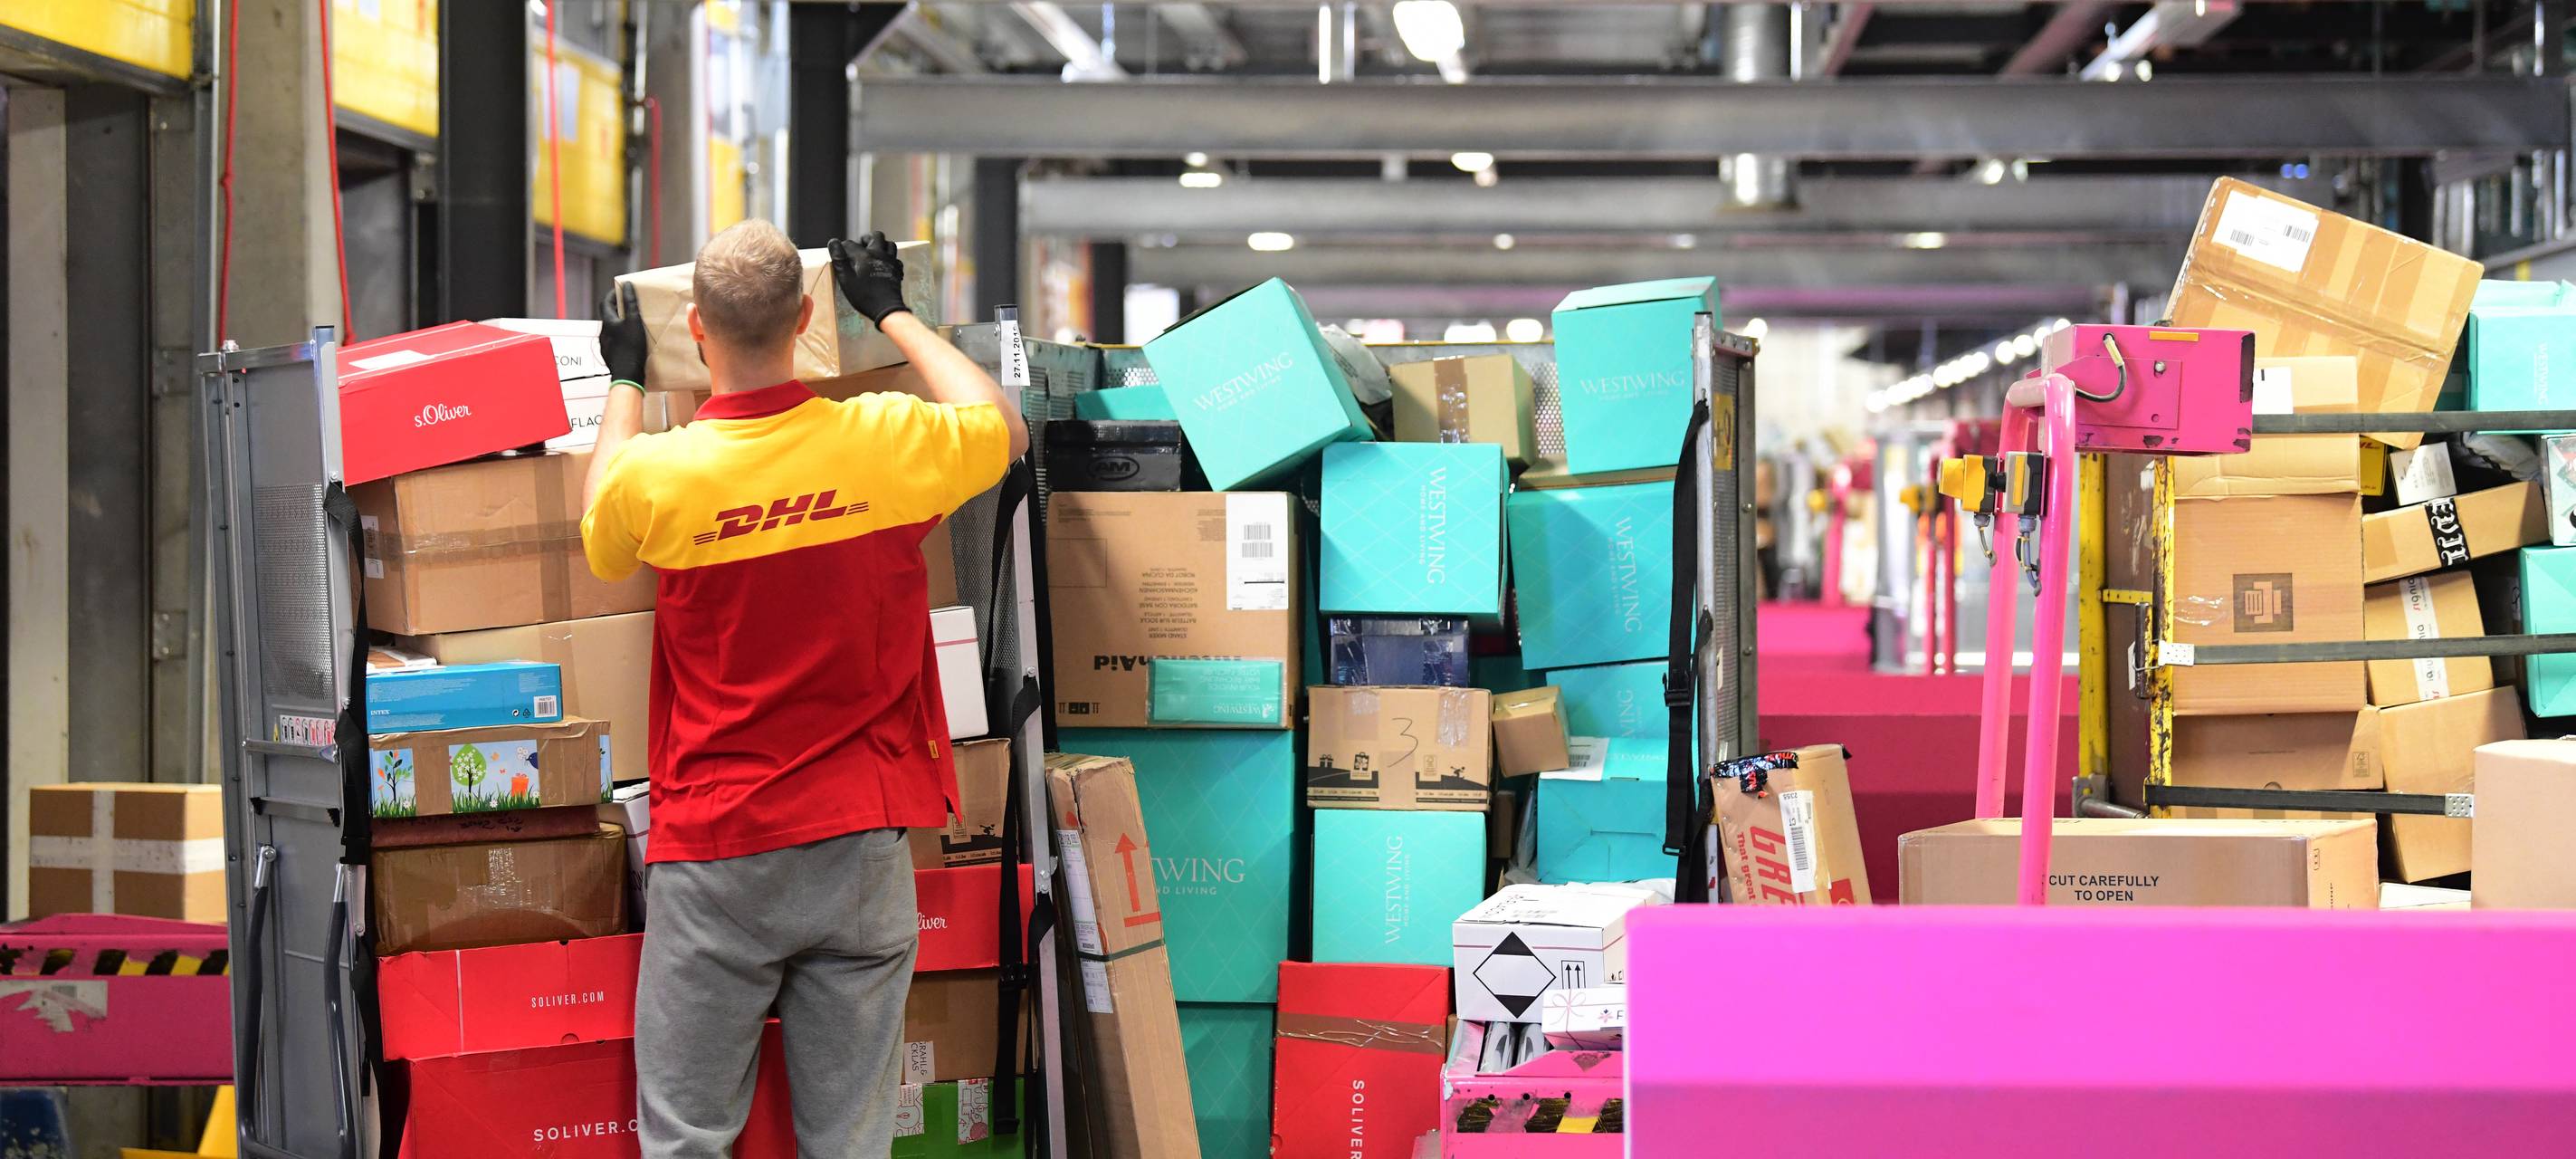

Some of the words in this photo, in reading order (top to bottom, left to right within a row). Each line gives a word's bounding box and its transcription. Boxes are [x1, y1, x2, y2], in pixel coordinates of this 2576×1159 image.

[1192, 350, 1293, 411] WESTWING
[1578, 369, 1685, 395] WESTWING
[414, 403, 472, 427] s.Oliver
[714, 489, 849, 541] DHL
[1426, 466, 1447, 585] WESTWING
[1615, 516, 1643, 633] WESTWING
[1387, 716, 1419, 768] 3
[1175, 886, 1217, 896] LIVING
[1384, 834, 1403, 945] WESTWING
[2048, 875, 2075, 886] CUT
[2079, 875, 2160, 886] CAREFULLY
[2075, 890, 2093, 901] TO
[2095, 890, 2133, 901] OPEN
[531, 991, 605, 1008] SOLIVER.COM
[1350, 1079, 1366, 1159] SOLIVER
